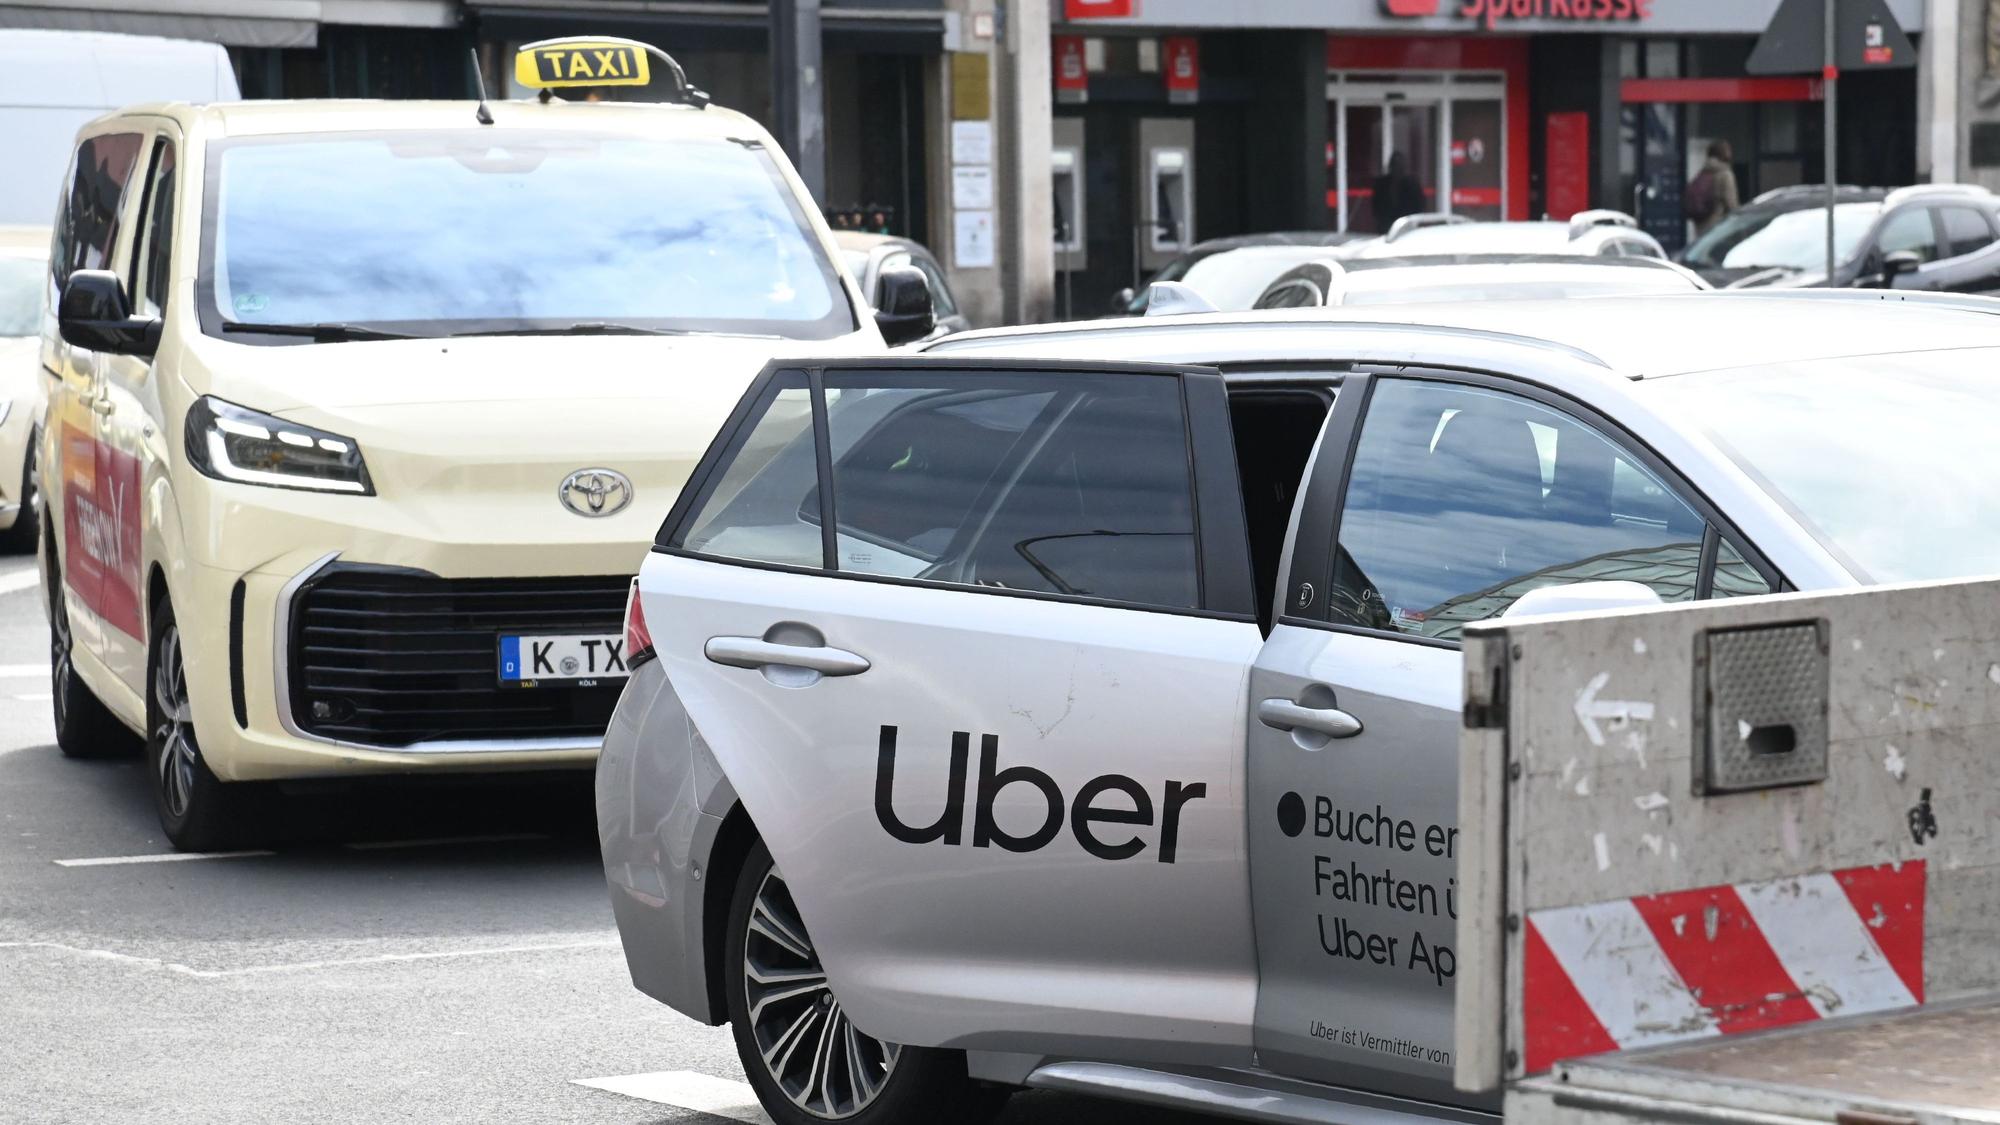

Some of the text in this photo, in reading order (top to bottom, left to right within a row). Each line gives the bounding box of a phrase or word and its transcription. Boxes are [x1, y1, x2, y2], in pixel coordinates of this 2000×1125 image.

[543, 50, 631, 79] TAXI
[506, 662, 514, 672] D
[532, 639, 625, 674] K TX
[579, 679, 597, 687] KÖLN
[874, 724, 1207, 864] Uber
[1314, 795, 1416, 852] Buche
[1314, 855, 1438, 916] Fahrten
[1317, 914, 1456, 987] Uber Ap
[1310, 1020, 1338, 1041] Uber
[1341, 1026, 1356, 1046] ist
[1359, 1030, 1424, 1060] Vermittler
[1426, 1049, 1450, 1065] von
